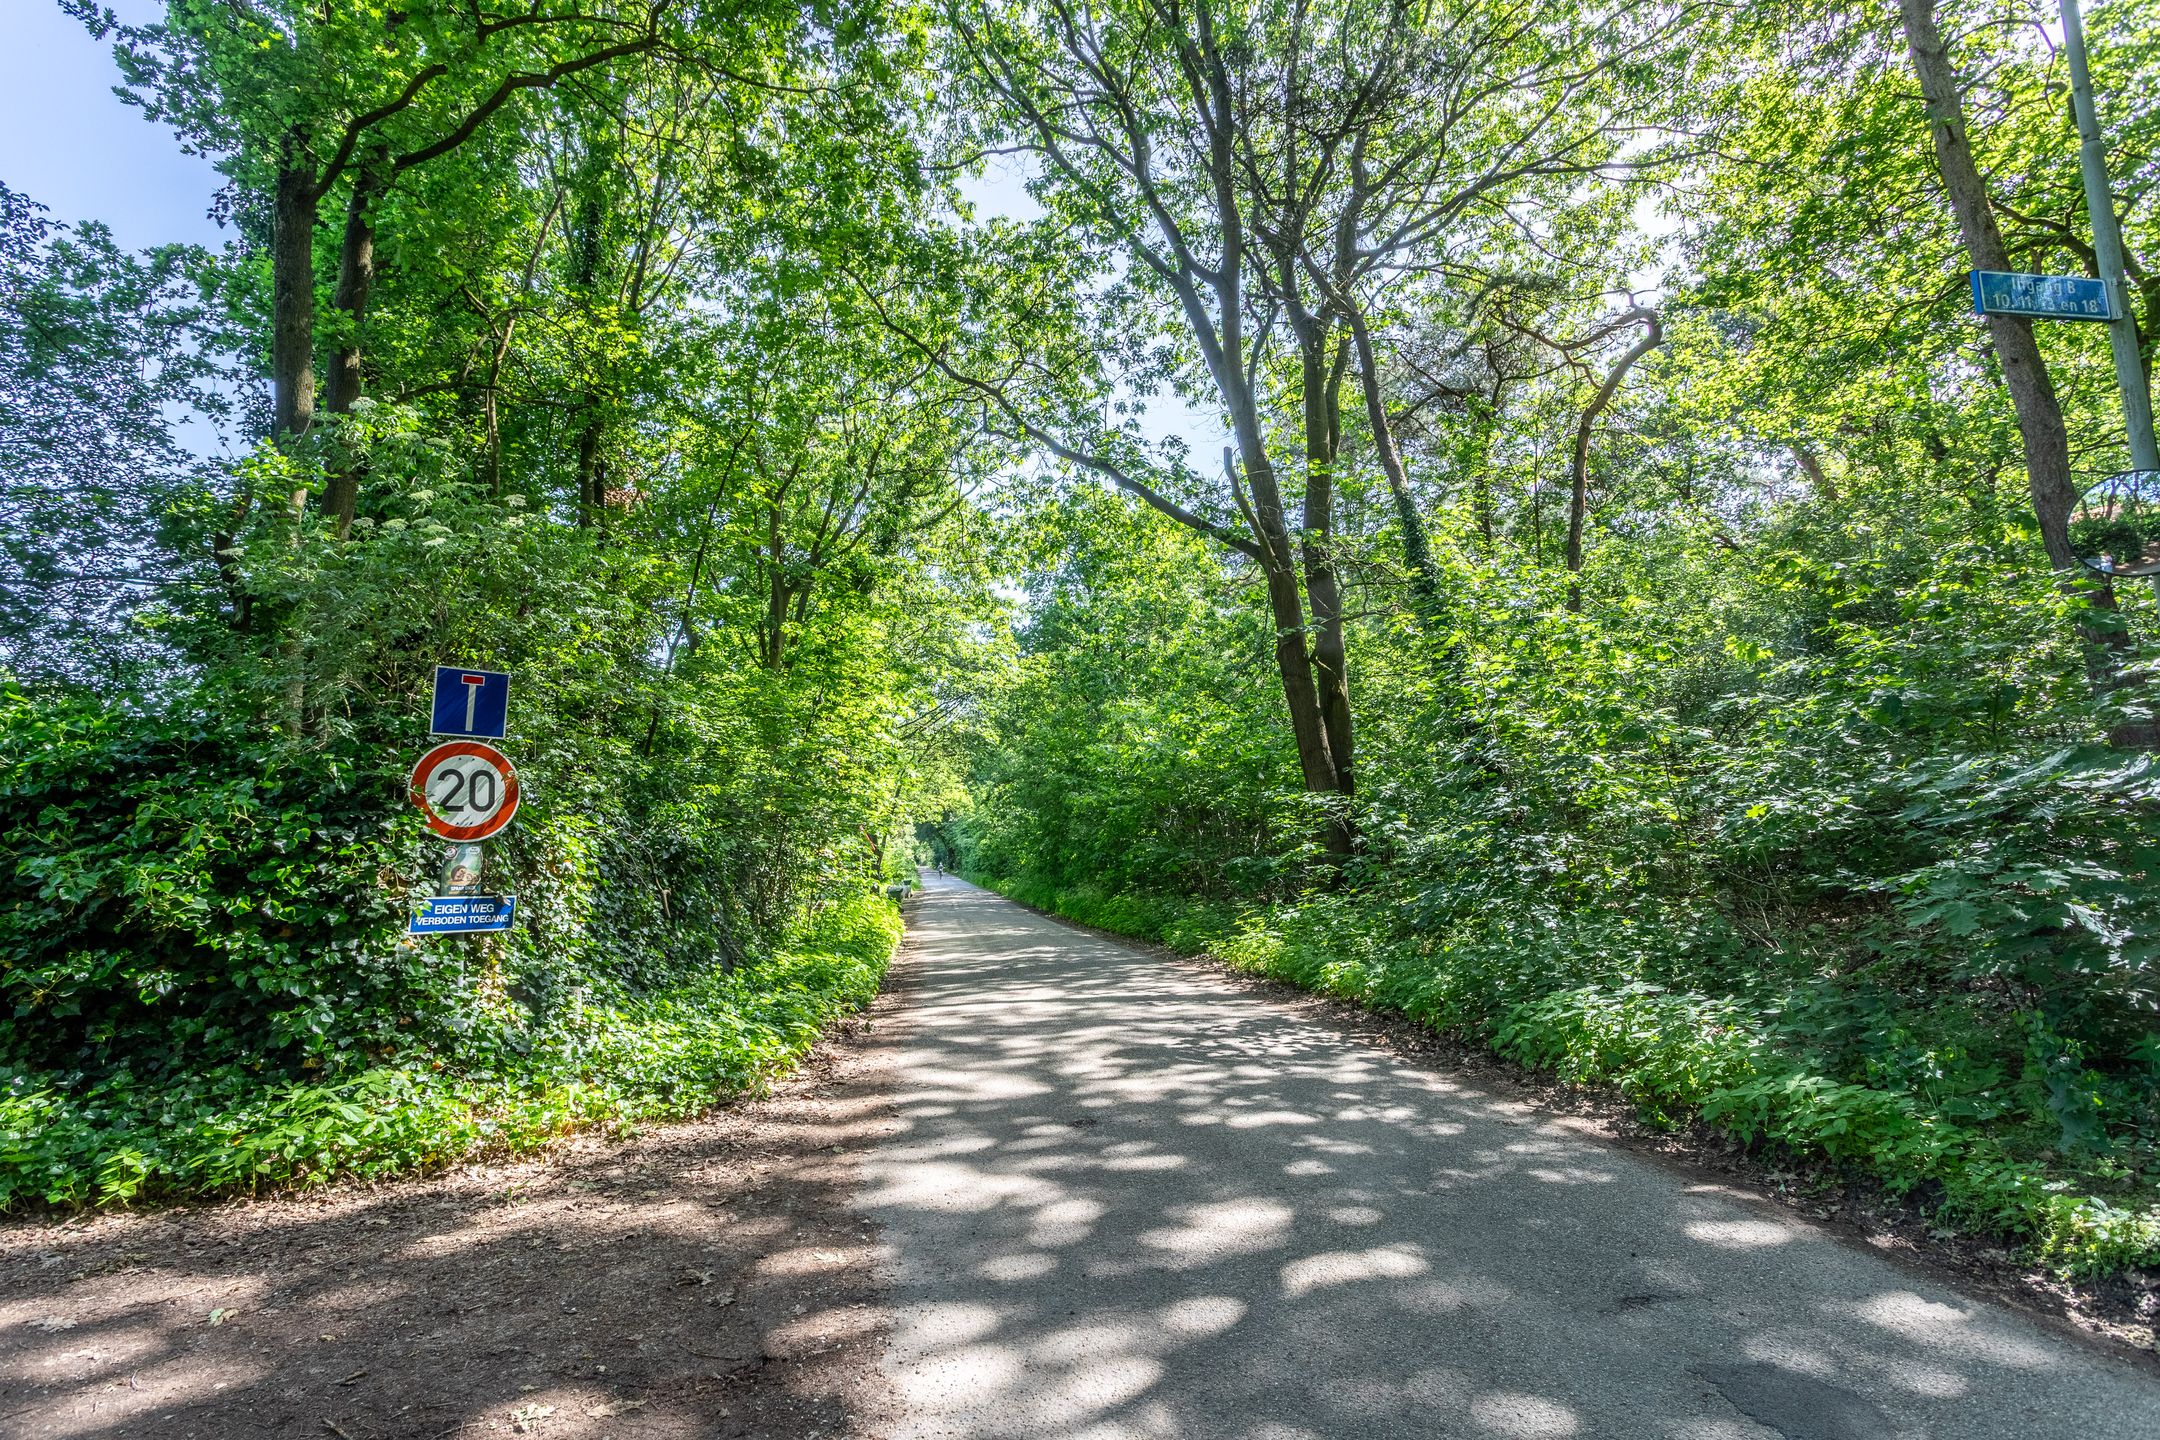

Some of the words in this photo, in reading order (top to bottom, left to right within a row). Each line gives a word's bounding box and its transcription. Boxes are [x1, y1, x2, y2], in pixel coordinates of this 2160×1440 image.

[2068, 281, 2076, 294] B
[2061, 301, 2078, 312] en
[2081, 299, 2099, 313] 18
[437, 768, 496, 813] 20
[434, 904, 468, 915] EIGEN
[470, 903, 495, 913] WEG
[416, 916, 467, 926] VERBODEN
[468, 914, 509, 924] TOEGANG
